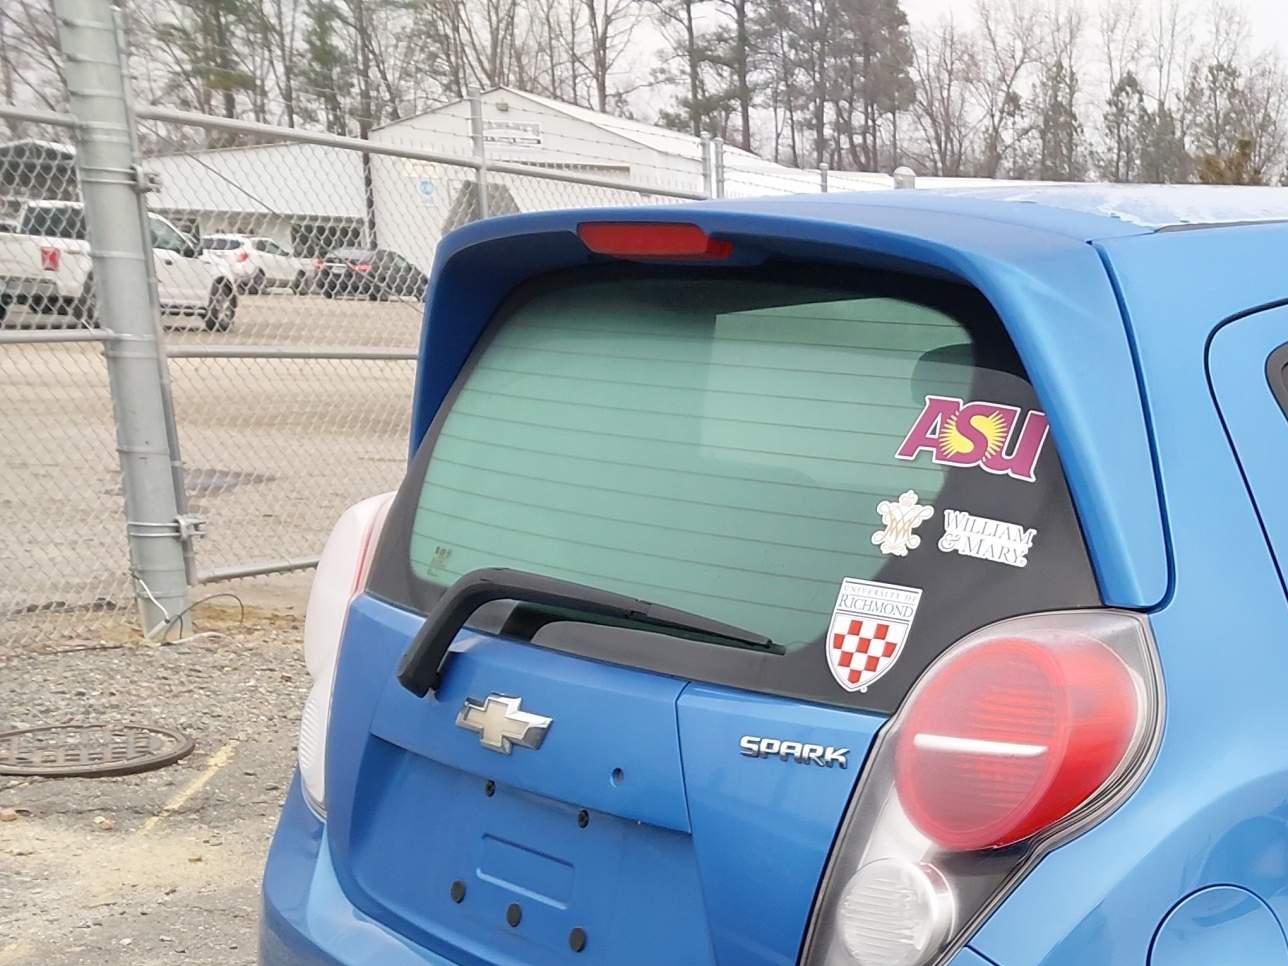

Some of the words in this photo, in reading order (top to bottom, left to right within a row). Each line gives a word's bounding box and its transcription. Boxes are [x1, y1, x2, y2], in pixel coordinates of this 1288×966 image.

[895, 395, 1049, 481] ASU
[940, 532, 960, 550] &
[944, 511, 1034, 545] WILLIAM
[839, 593, 914, 618] RICHMOND
[843, 584, 901, 599] UNIVERSITY
[739, 735, 850, 769] SPARK
